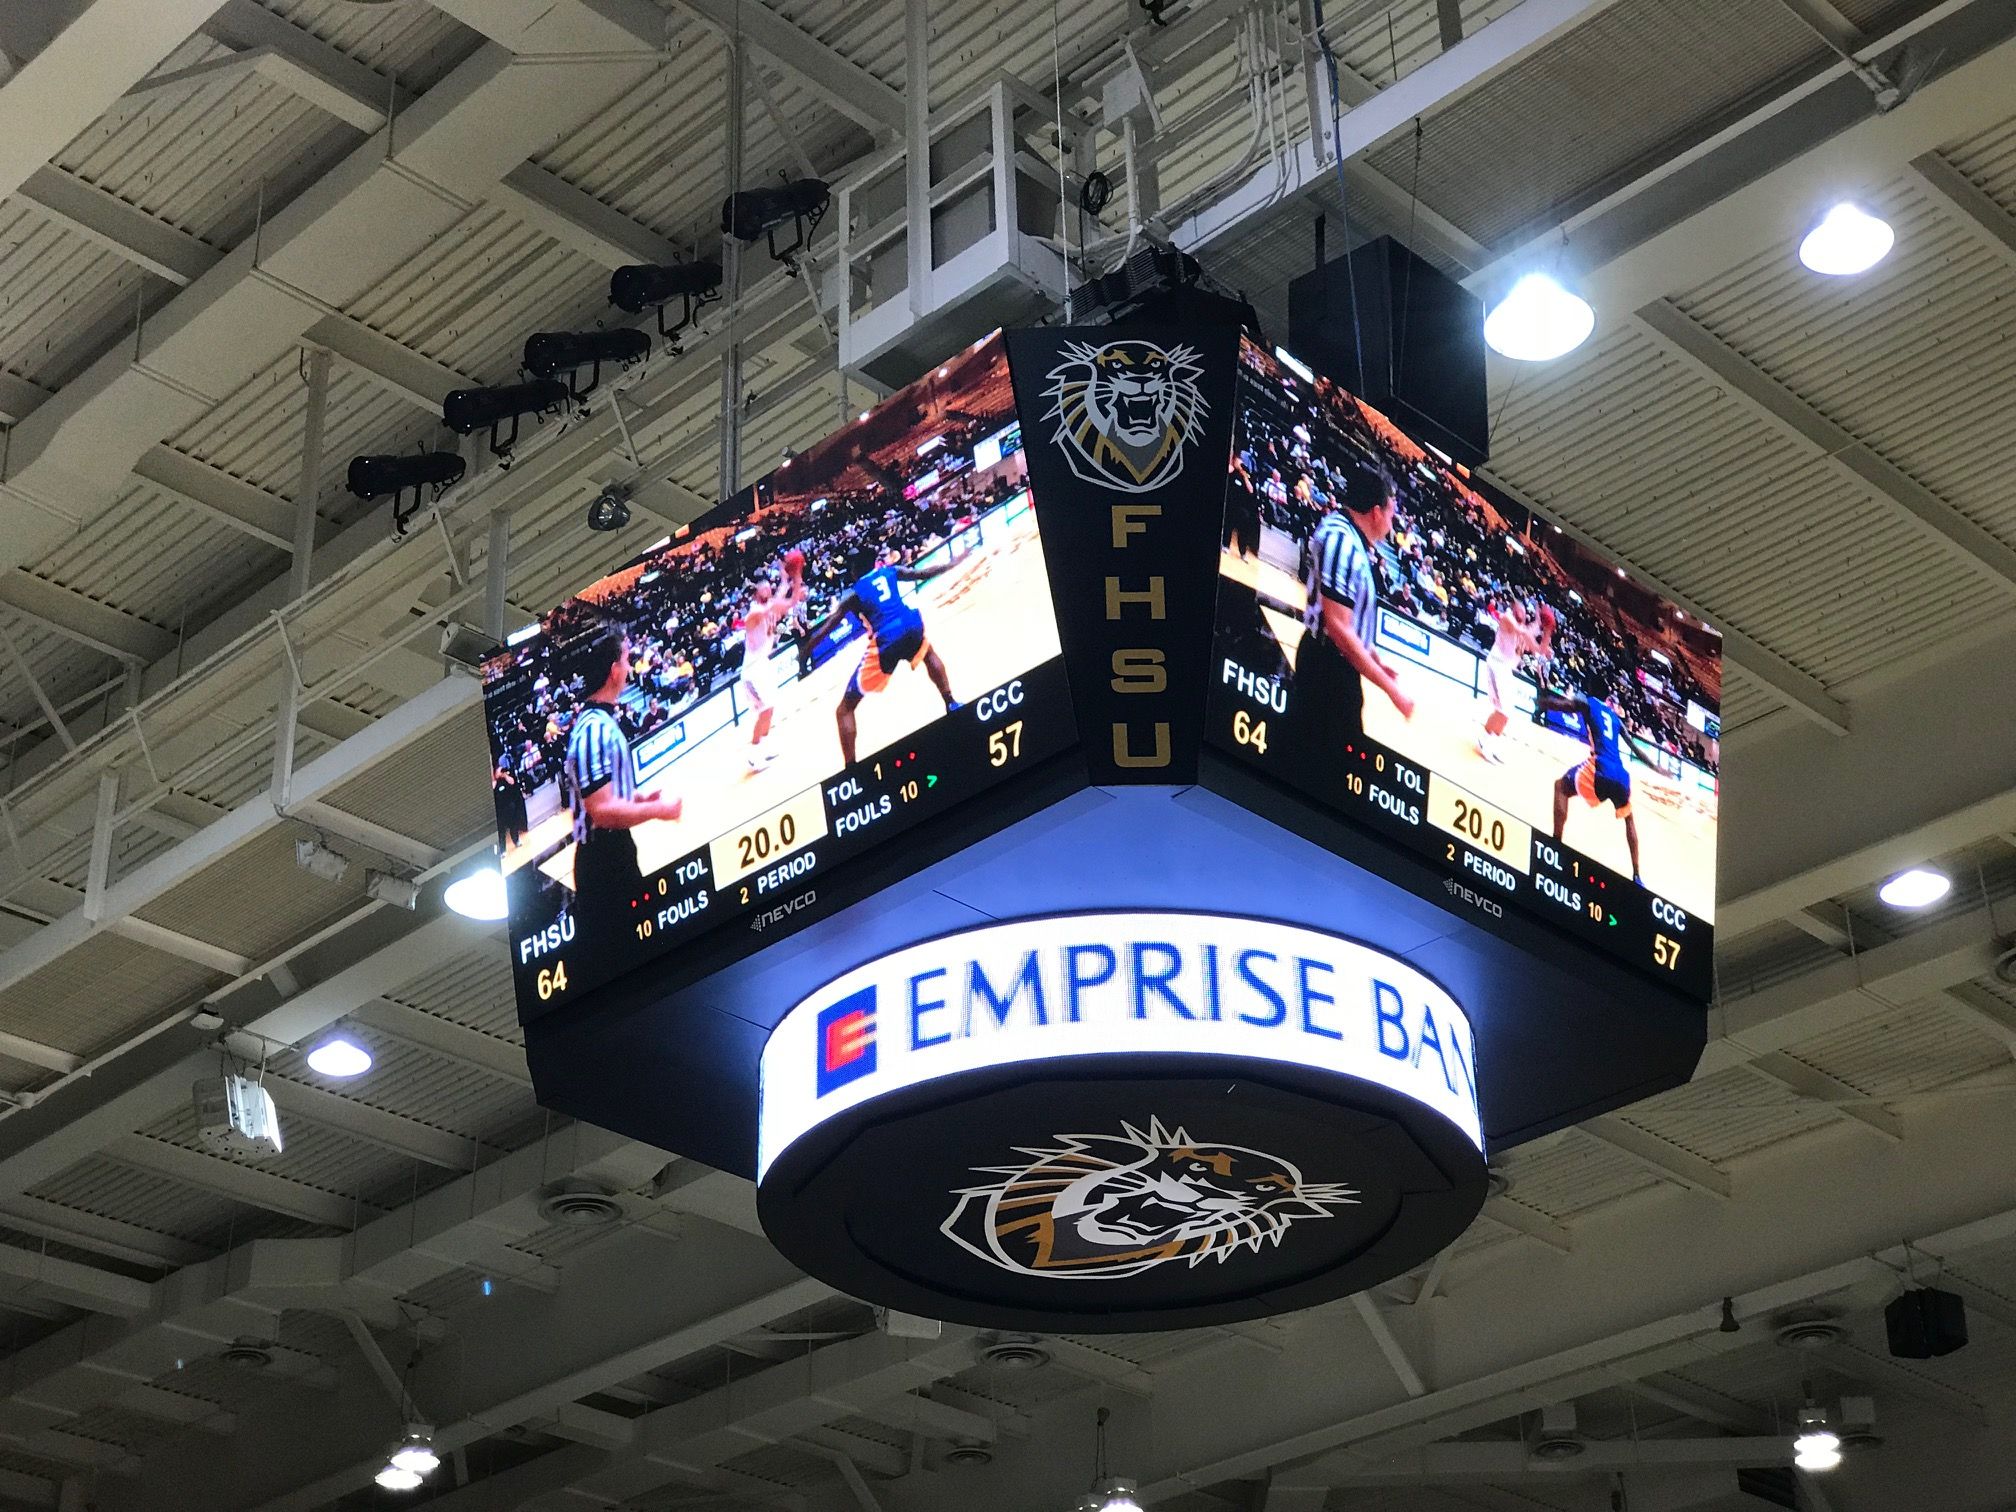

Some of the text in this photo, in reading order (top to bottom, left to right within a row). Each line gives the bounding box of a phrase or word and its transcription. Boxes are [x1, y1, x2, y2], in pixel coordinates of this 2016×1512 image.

[872, 575, 891, 602] 3
[1105, 505, 1172, 768] FHSU
[975, 680, 1025, 723] CCC
[1223, 659, 1287, 714] FHSU
[989, 721, 1023, 767] 57
[1233, 711, 1268, 755] 64
[1601, 710, 1613, 740] 3
[828, 763, 882, 807] TOL 1
[1375, 753, 1425, 795] 0 TOL
[835, 781, 919, 837] FOULS 10
[1346, 773, 1420, 825] 10 FOULS
[739, 813, 796, 869] 20.0
[1453, 799, 1504, 851] 20.0
[658, 857, 708, 896] 0 TOL
[739, 851, 816, 905] 2 PERIOD
[1446, 843, 1517, 891] 2 PERIOD
[1535, 840, 1580, 878] TOL 1
[635, 889, 709, 940] 10 FOULS
[1535, 873, 1603, 922] FOULS 10
[1652, 897, 1686, 932] CCC
[520, 914, 576, 965] FHSU
[1653, 934, 1681, 971] 57
[537, 960, 568, 1000] 64
[905, 941, 1344, 1052] EMPRISE
